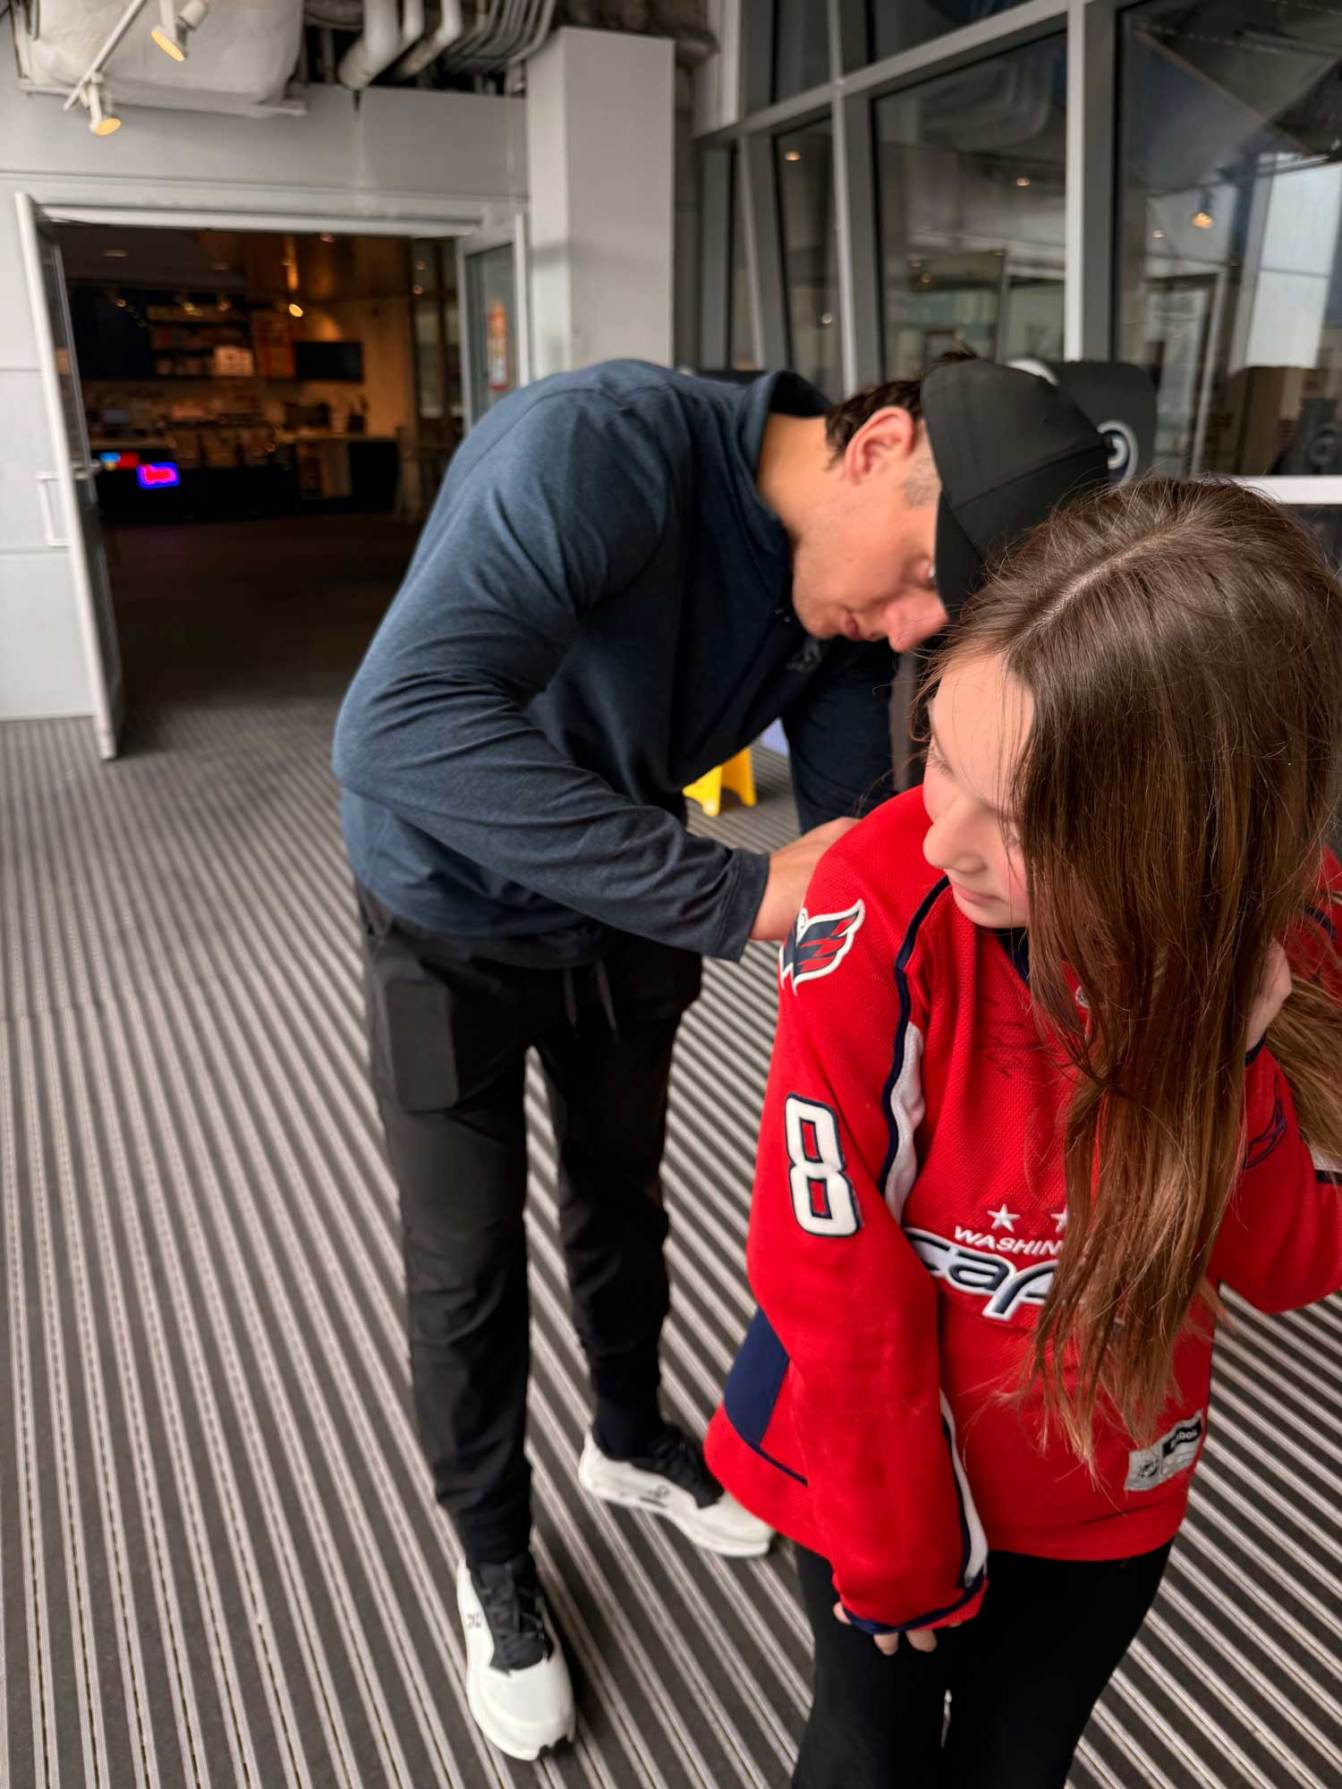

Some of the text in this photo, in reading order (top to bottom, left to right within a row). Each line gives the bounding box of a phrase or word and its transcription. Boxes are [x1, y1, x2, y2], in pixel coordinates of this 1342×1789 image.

[784, 1092, 862, 1237] 8
[904, 1227, 1059, 1321] cap
[954, 1225, 1063, 1257] WASHIN
